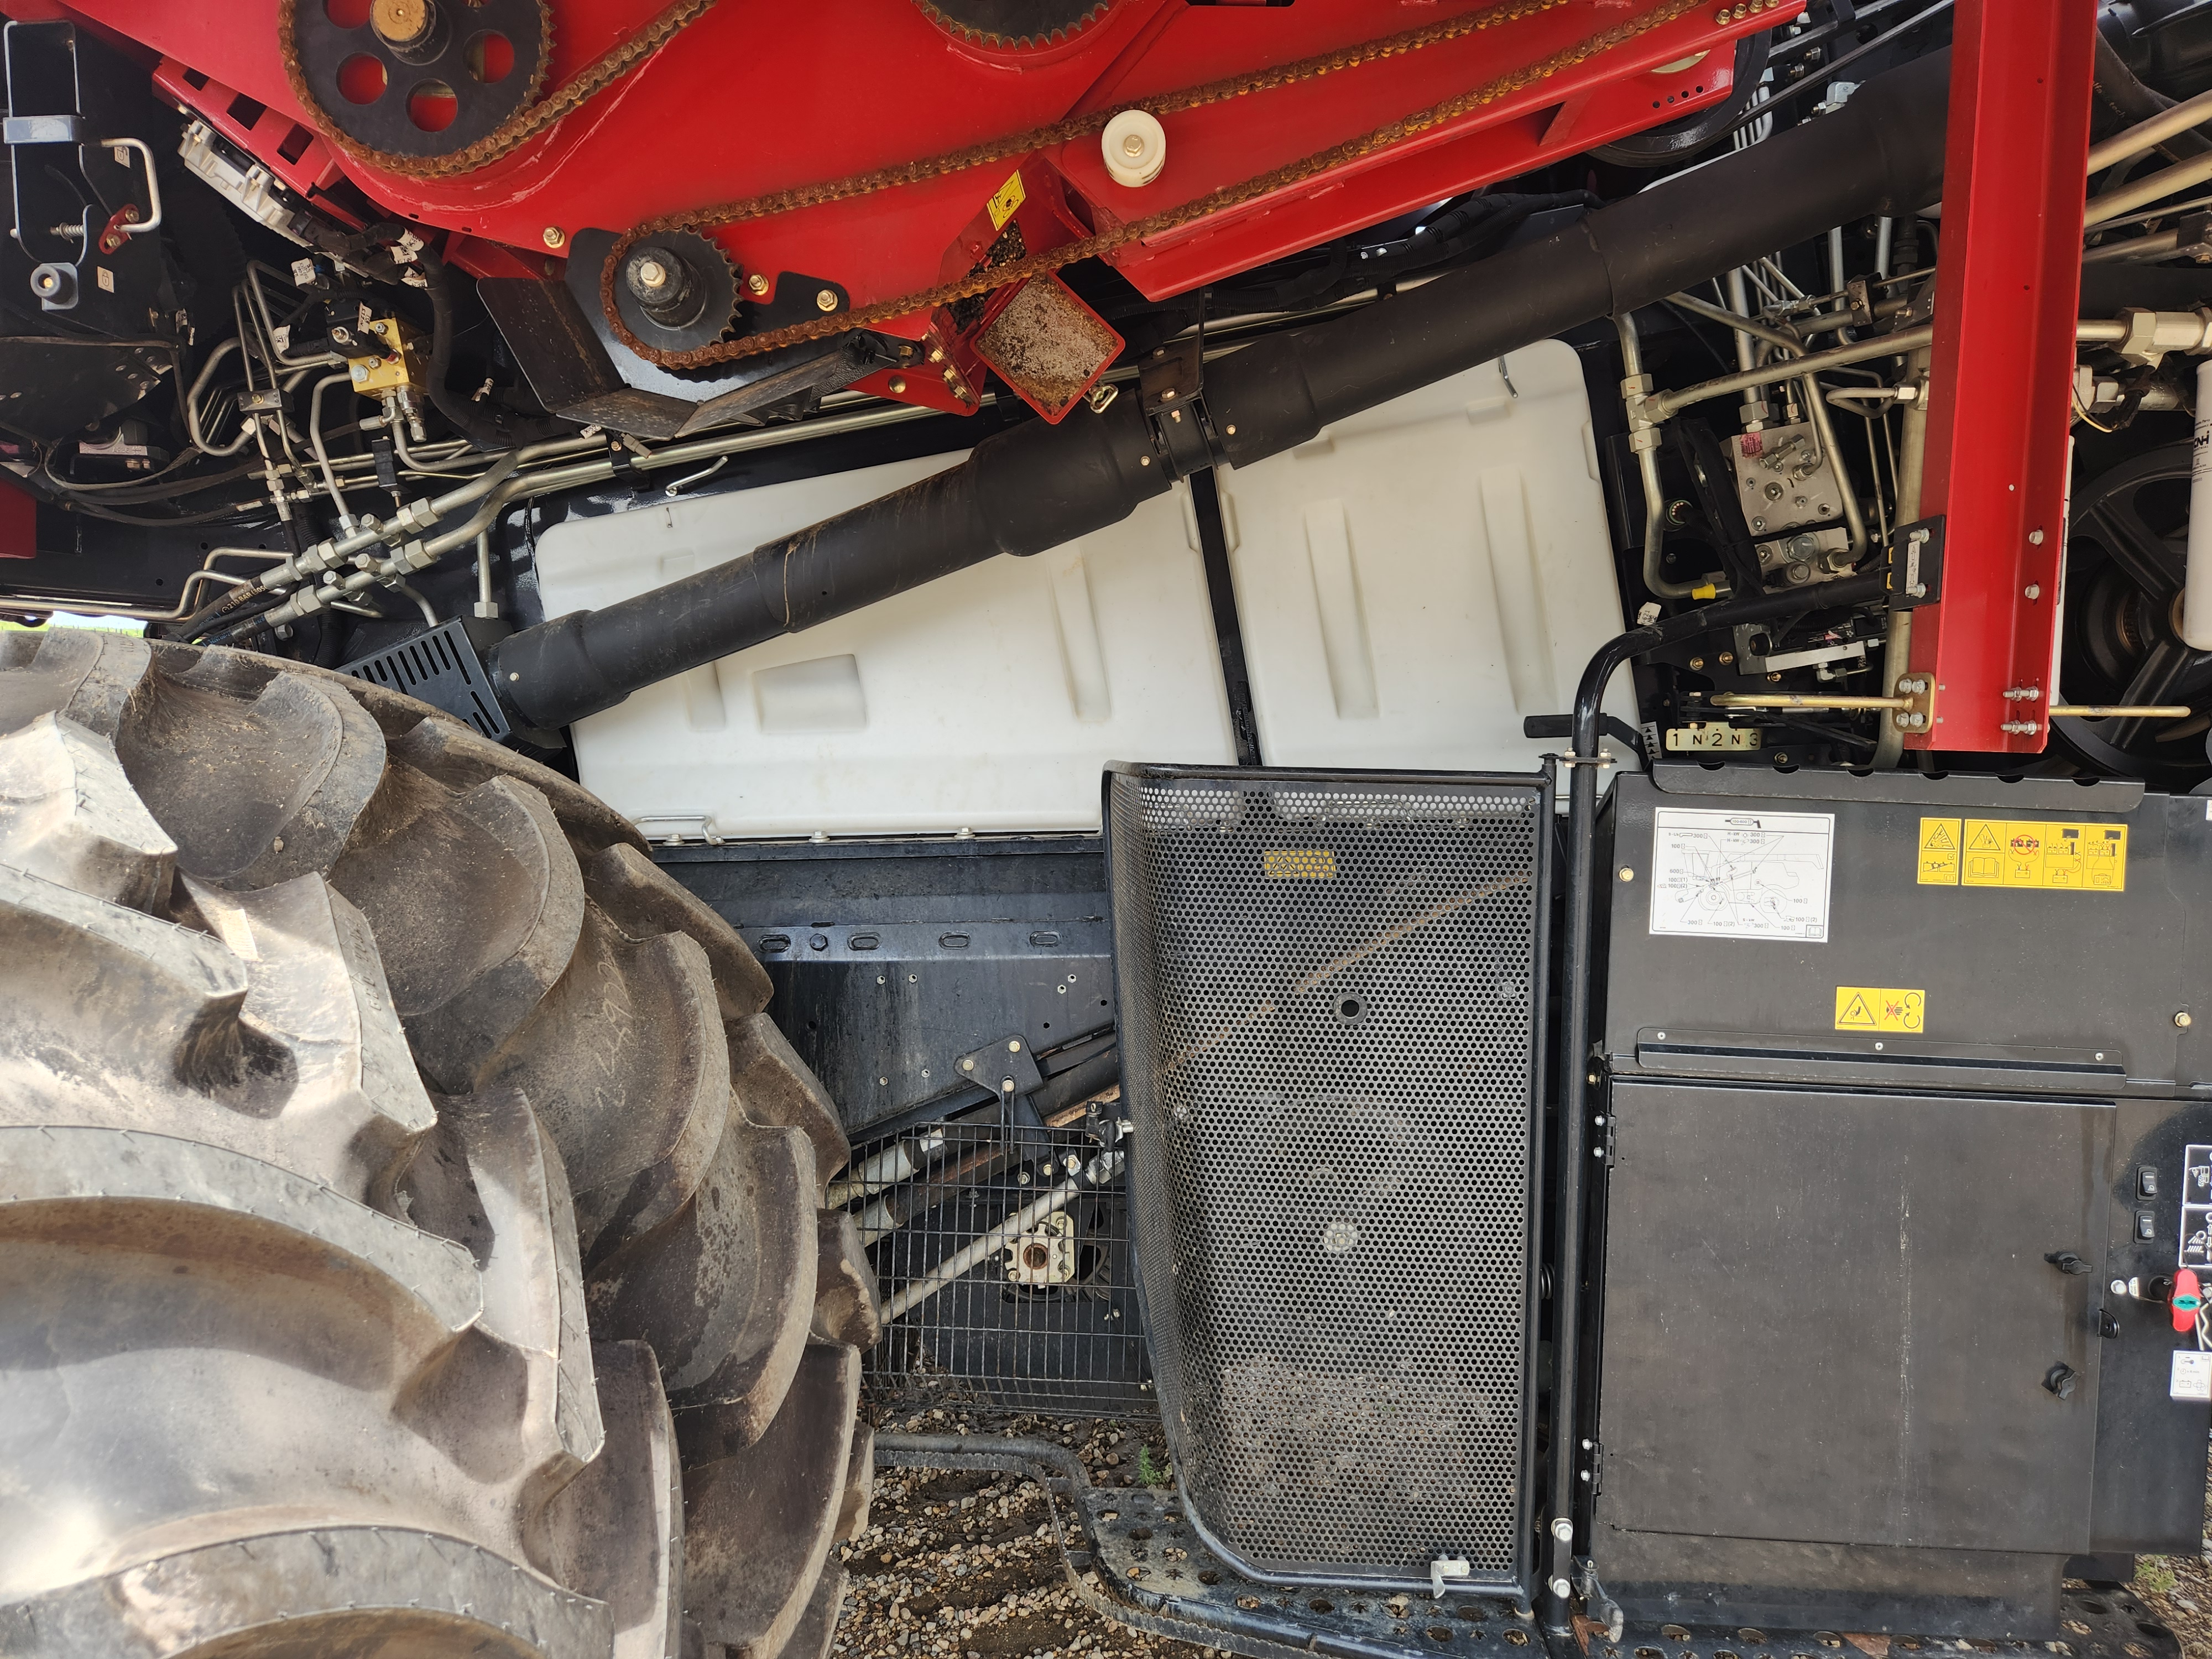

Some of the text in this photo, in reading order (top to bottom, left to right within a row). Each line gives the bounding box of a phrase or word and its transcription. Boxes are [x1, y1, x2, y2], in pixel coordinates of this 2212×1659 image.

[227, 599, 240, 609] 210
[238, 592, 253, 602] BAR
[1673, 733, 1757, 746] 1 N 2 N 3
